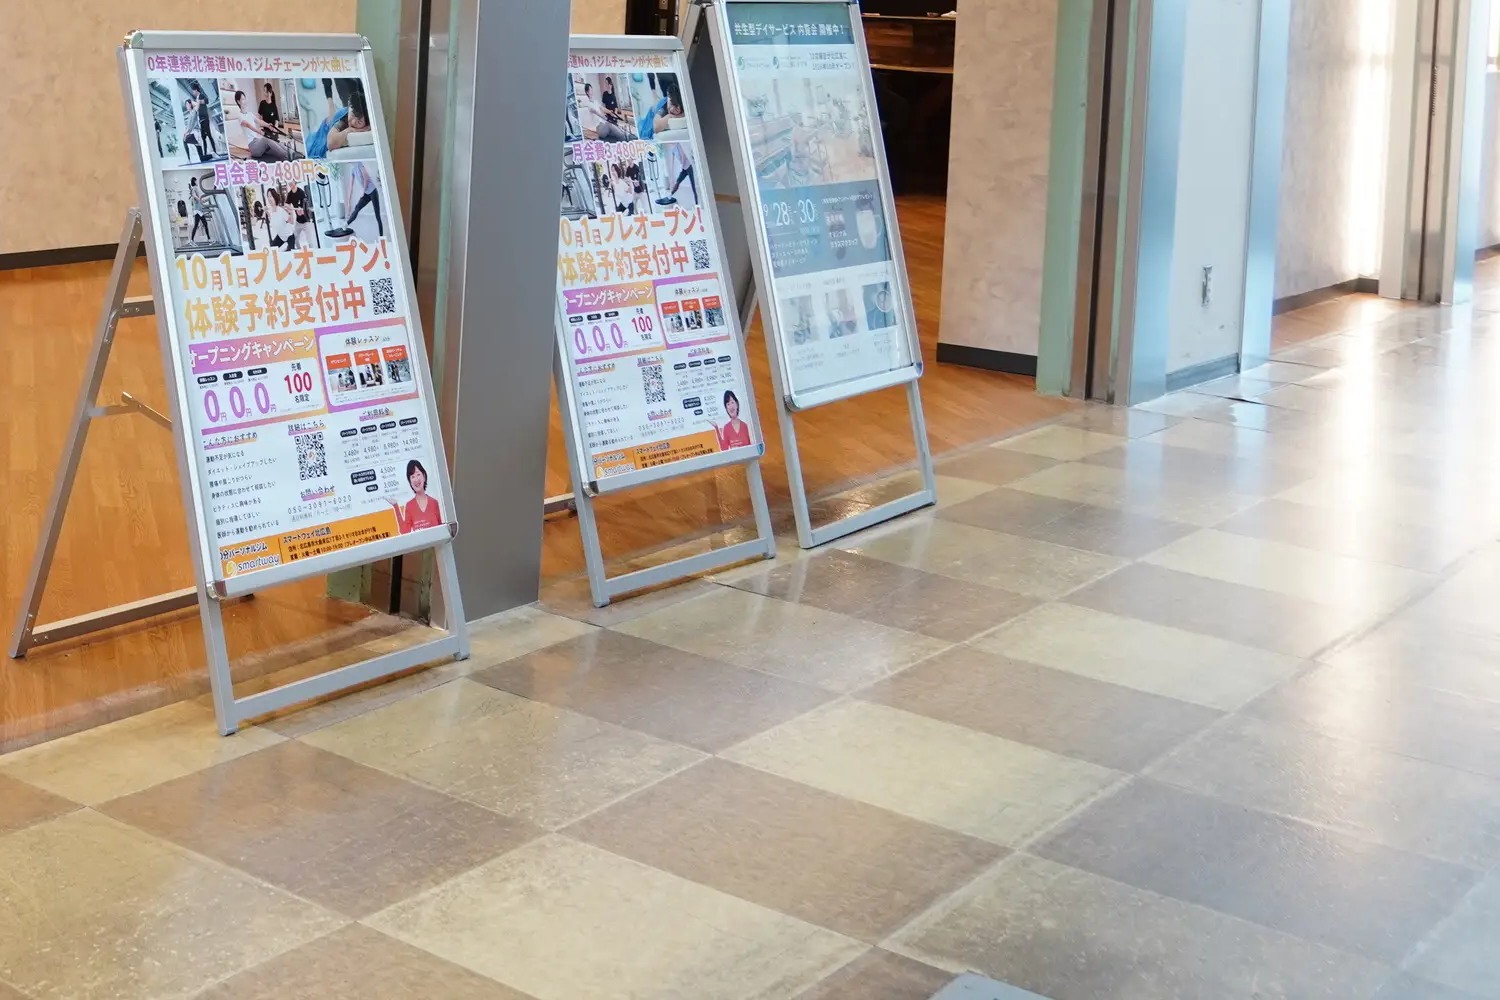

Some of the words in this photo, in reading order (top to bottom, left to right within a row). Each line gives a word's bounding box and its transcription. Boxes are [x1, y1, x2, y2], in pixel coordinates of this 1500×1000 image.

[558, 240, 689, 286] 体験予約受付中
[184, 280, 366, 340] 体験予約受付中
[631, 315, 653, 333] 100
[284, 372, 313, 394] 100
[238, 554, 280, 571] smartway
